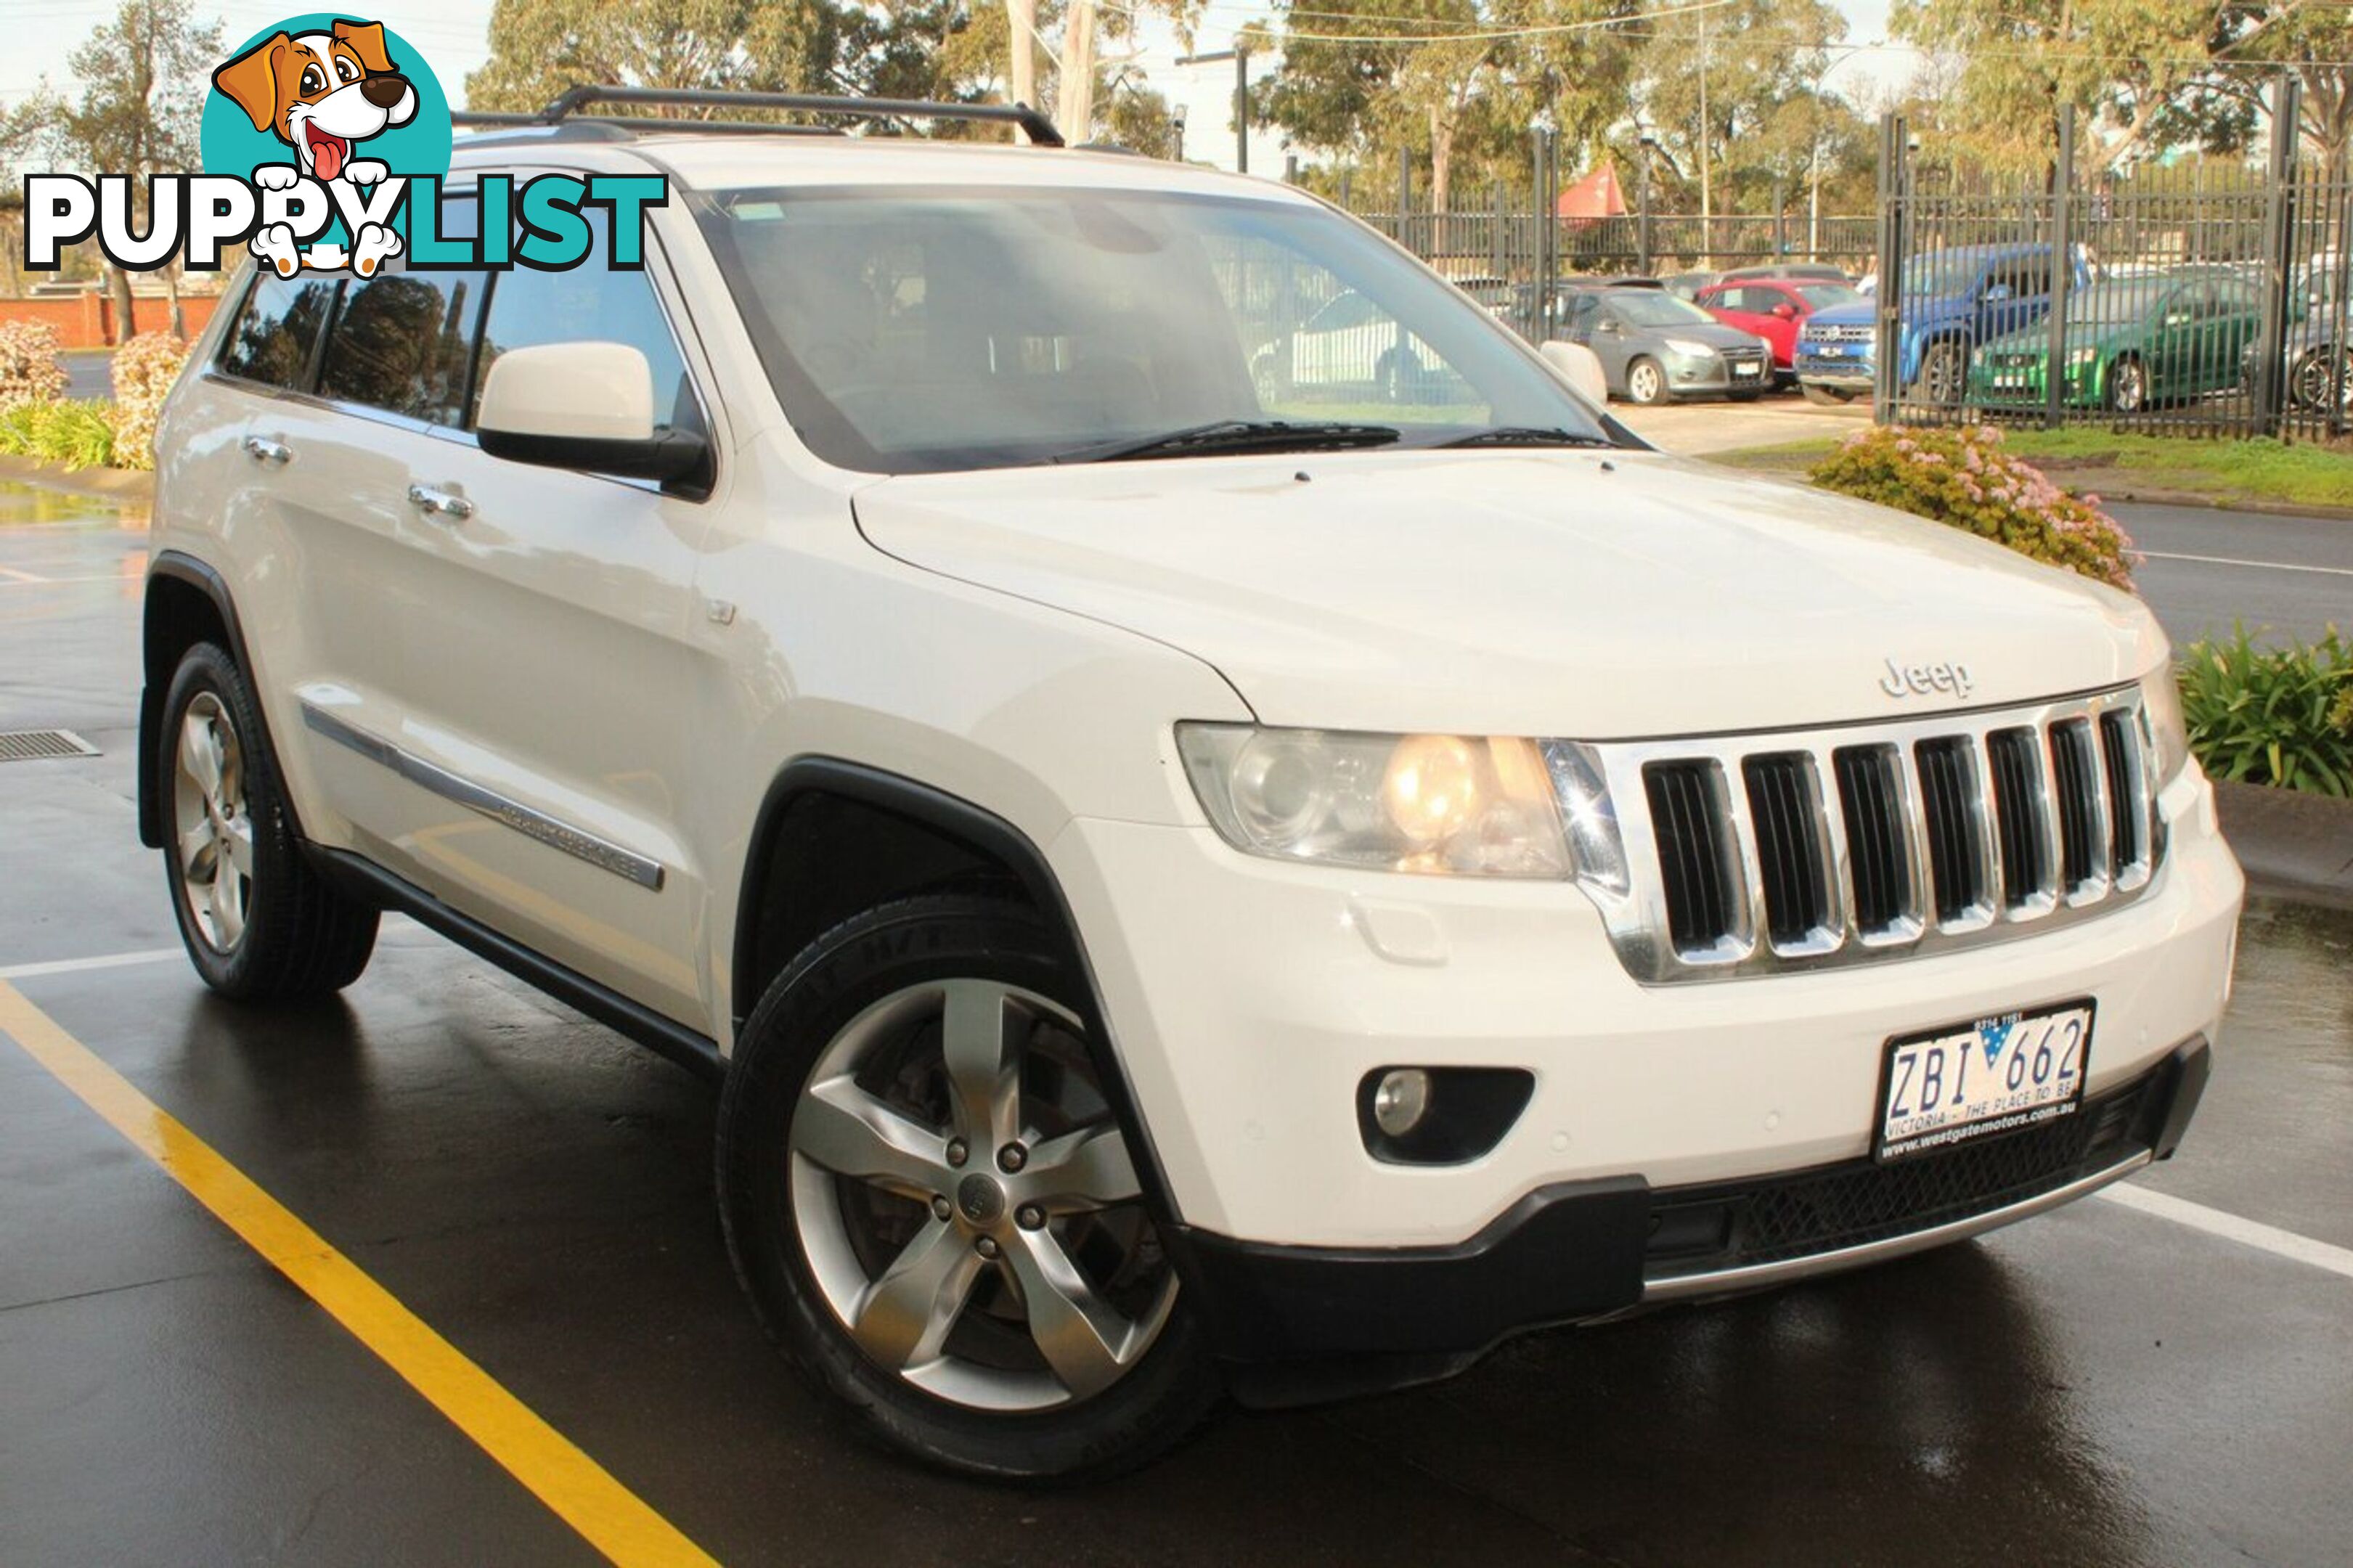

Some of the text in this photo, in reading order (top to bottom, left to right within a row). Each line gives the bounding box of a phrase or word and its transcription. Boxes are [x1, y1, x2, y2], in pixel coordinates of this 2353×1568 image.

[1879, 657, 1973, 699] Jeep
[1890, 1018, 2081, 1119] ZBI 662
[1882, 1101, 2076, 1158] www.westgatemotors.com.au
[1888, 1111, 1946, 1137] VICTORIA
[1965, 1101, 1988, 1119] THE
[1994, 1090, 2030, 1112] PLACE
[2035, 1086, 2050, 1102] TO
[2057, 1080, 2071, 1097] BE
